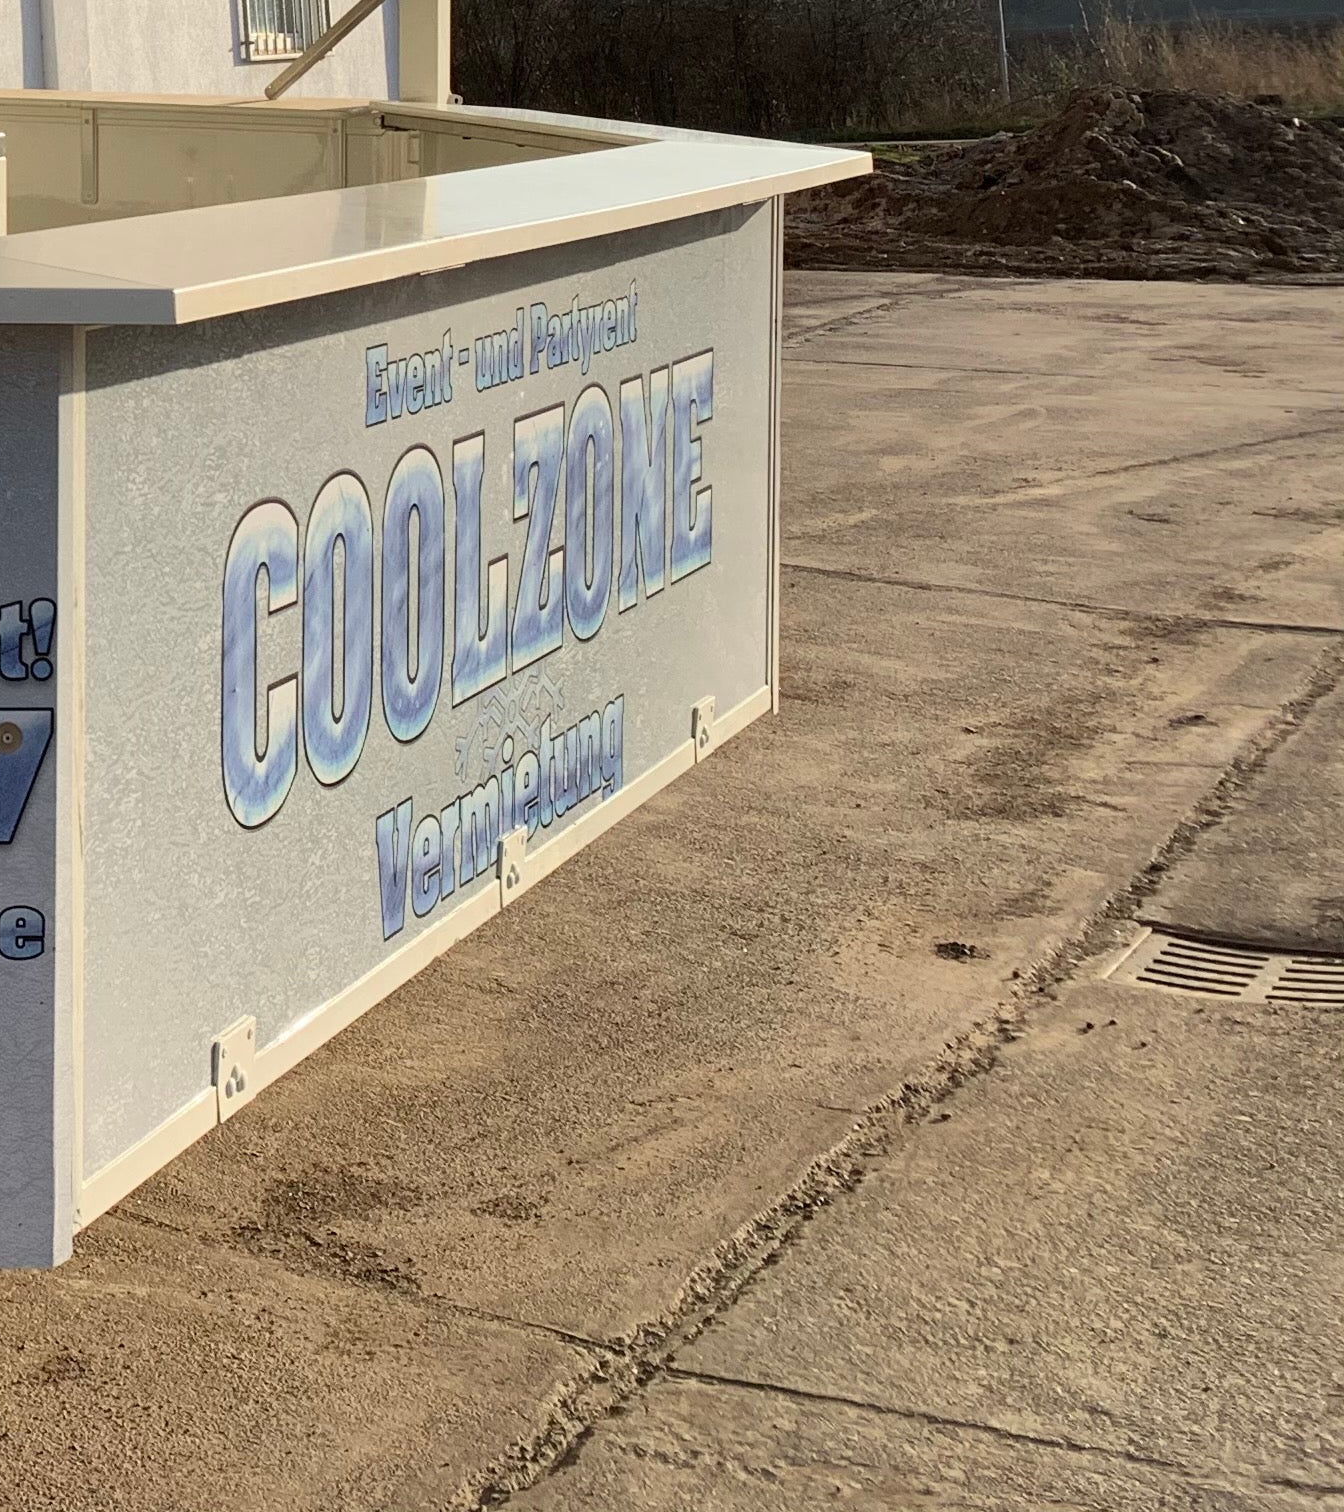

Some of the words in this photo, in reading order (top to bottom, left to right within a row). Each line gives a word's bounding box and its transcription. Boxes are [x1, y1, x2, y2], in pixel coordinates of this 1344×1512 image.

[475, 308, 524, 392] und
[530, 278, 638, 375] Partyrent
[222, 347, 714, 829] COOLZONE
[376, 694, 624, 941] Vermietung
